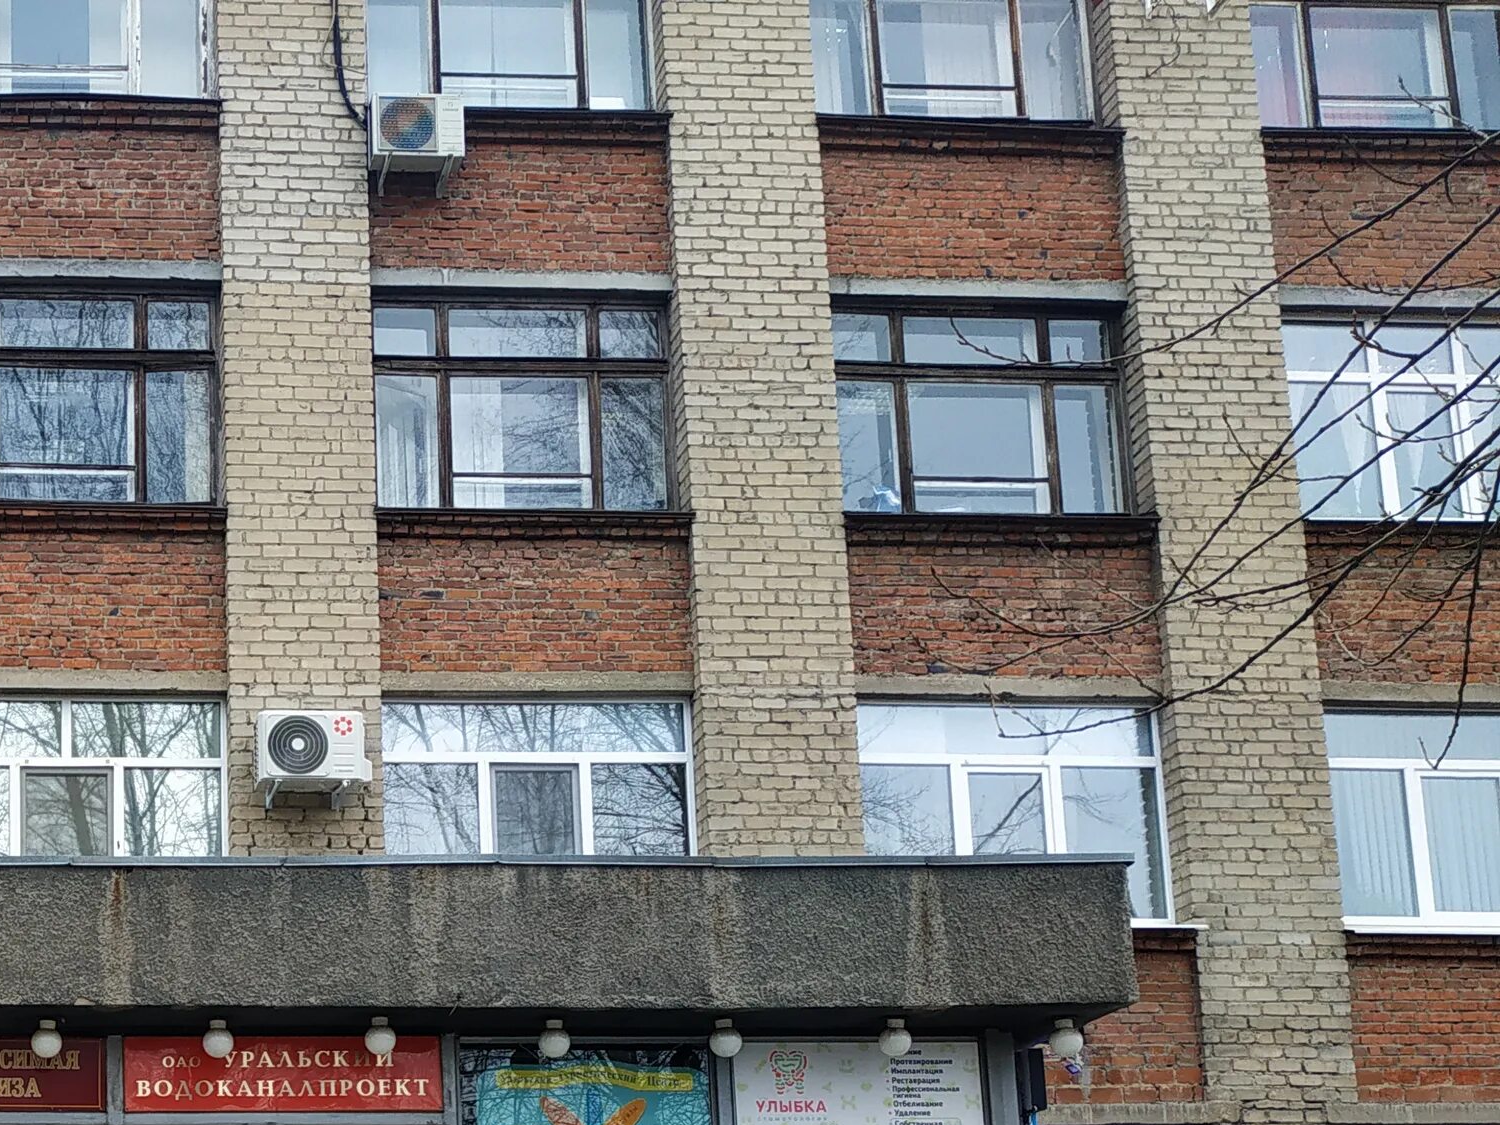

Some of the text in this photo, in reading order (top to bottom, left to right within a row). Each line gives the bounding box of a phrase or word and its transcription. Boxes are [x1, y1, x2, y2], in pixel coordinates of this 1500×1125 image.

[162, 1056, 200, 1069] ОАО
[890, 1058, 953, 1066] Протезирование
[892, 1077, 940, 1085] Реставрация
[136, 1079, 430, 1100] ВОДОКАНАЛПРОЕКТ
[756, 1100, 827, 1113] УЛЫБКА
